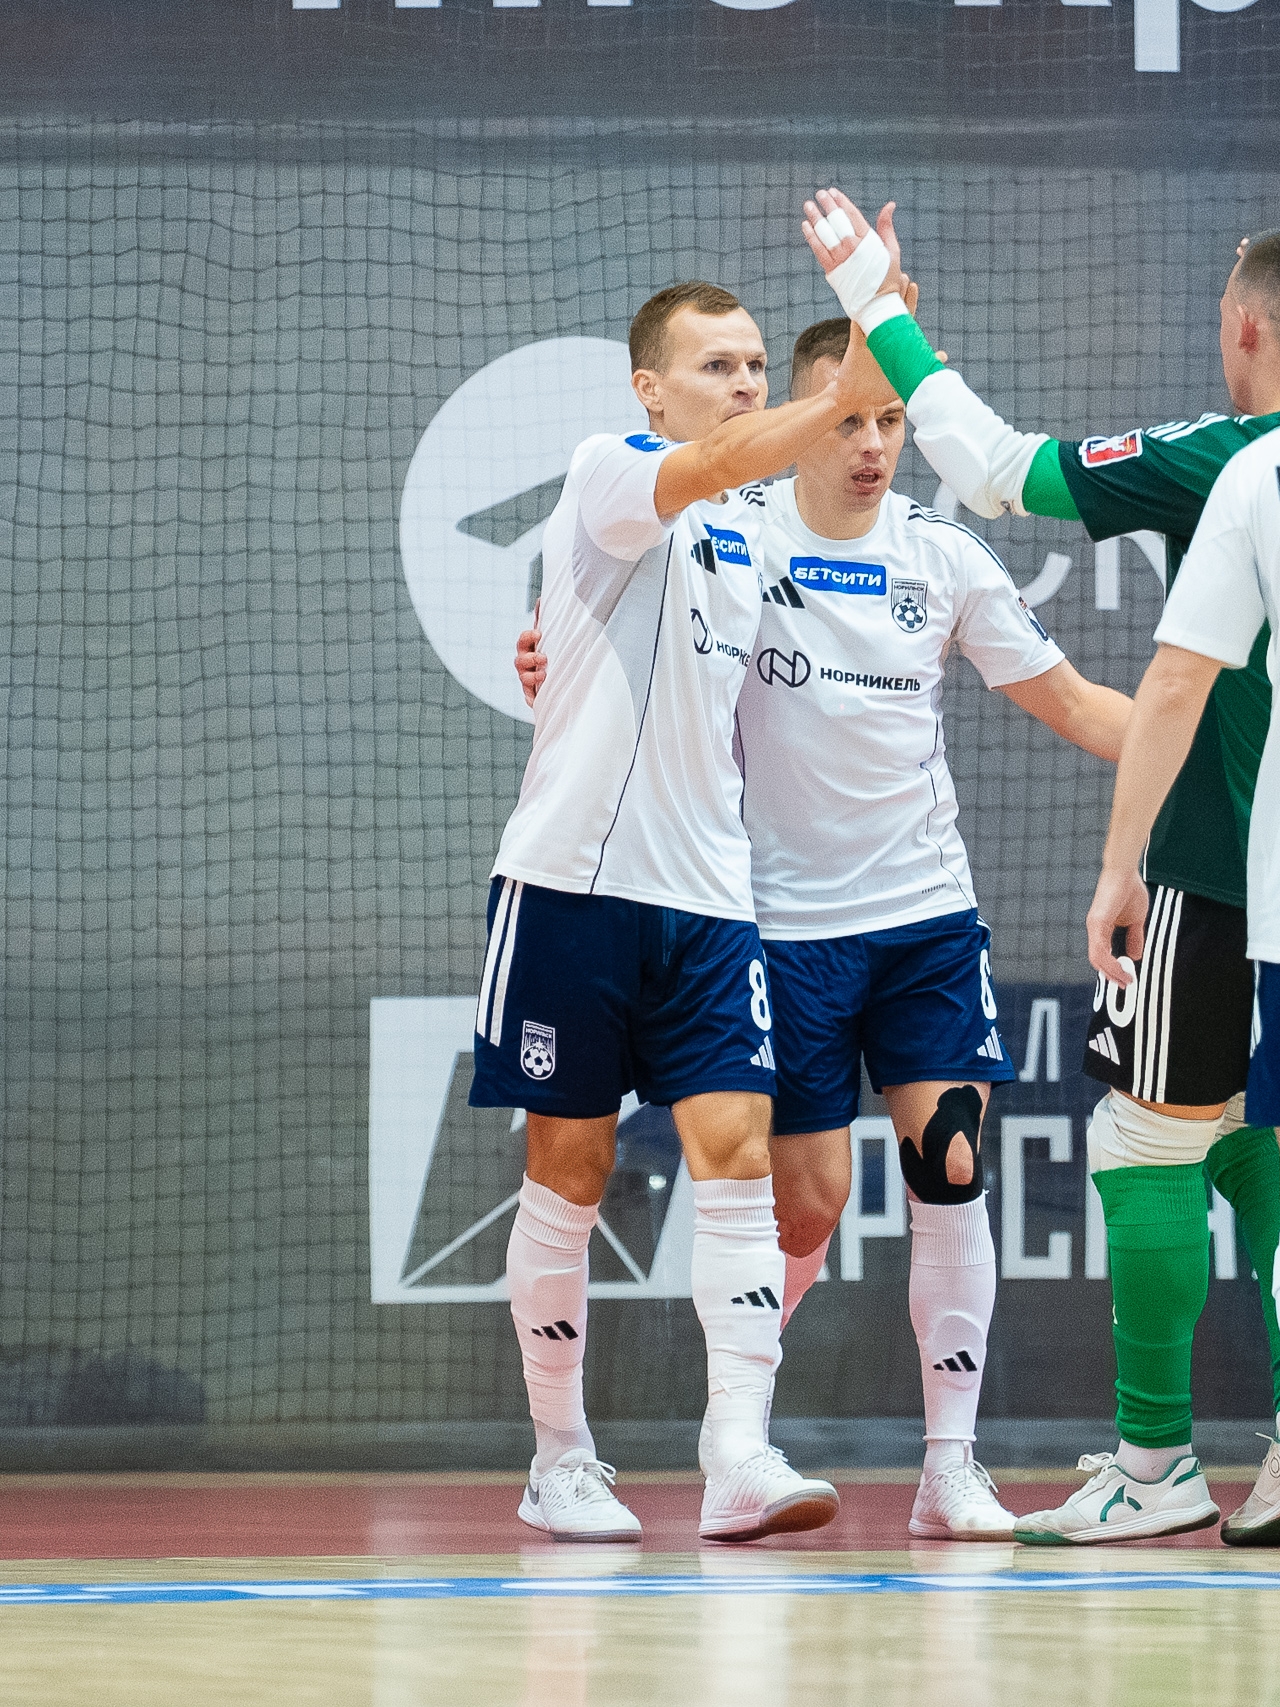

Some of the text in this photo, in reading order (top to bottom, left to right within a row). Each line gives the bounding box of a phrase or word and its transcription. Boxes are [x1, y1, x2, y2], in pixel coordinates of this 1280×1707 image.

[794, 567, 882, 587] БЕТСИТИ
[820, 667, 921, 692] НОРНИКЕЛЬ
[748, 959, 772, 1031] 8
